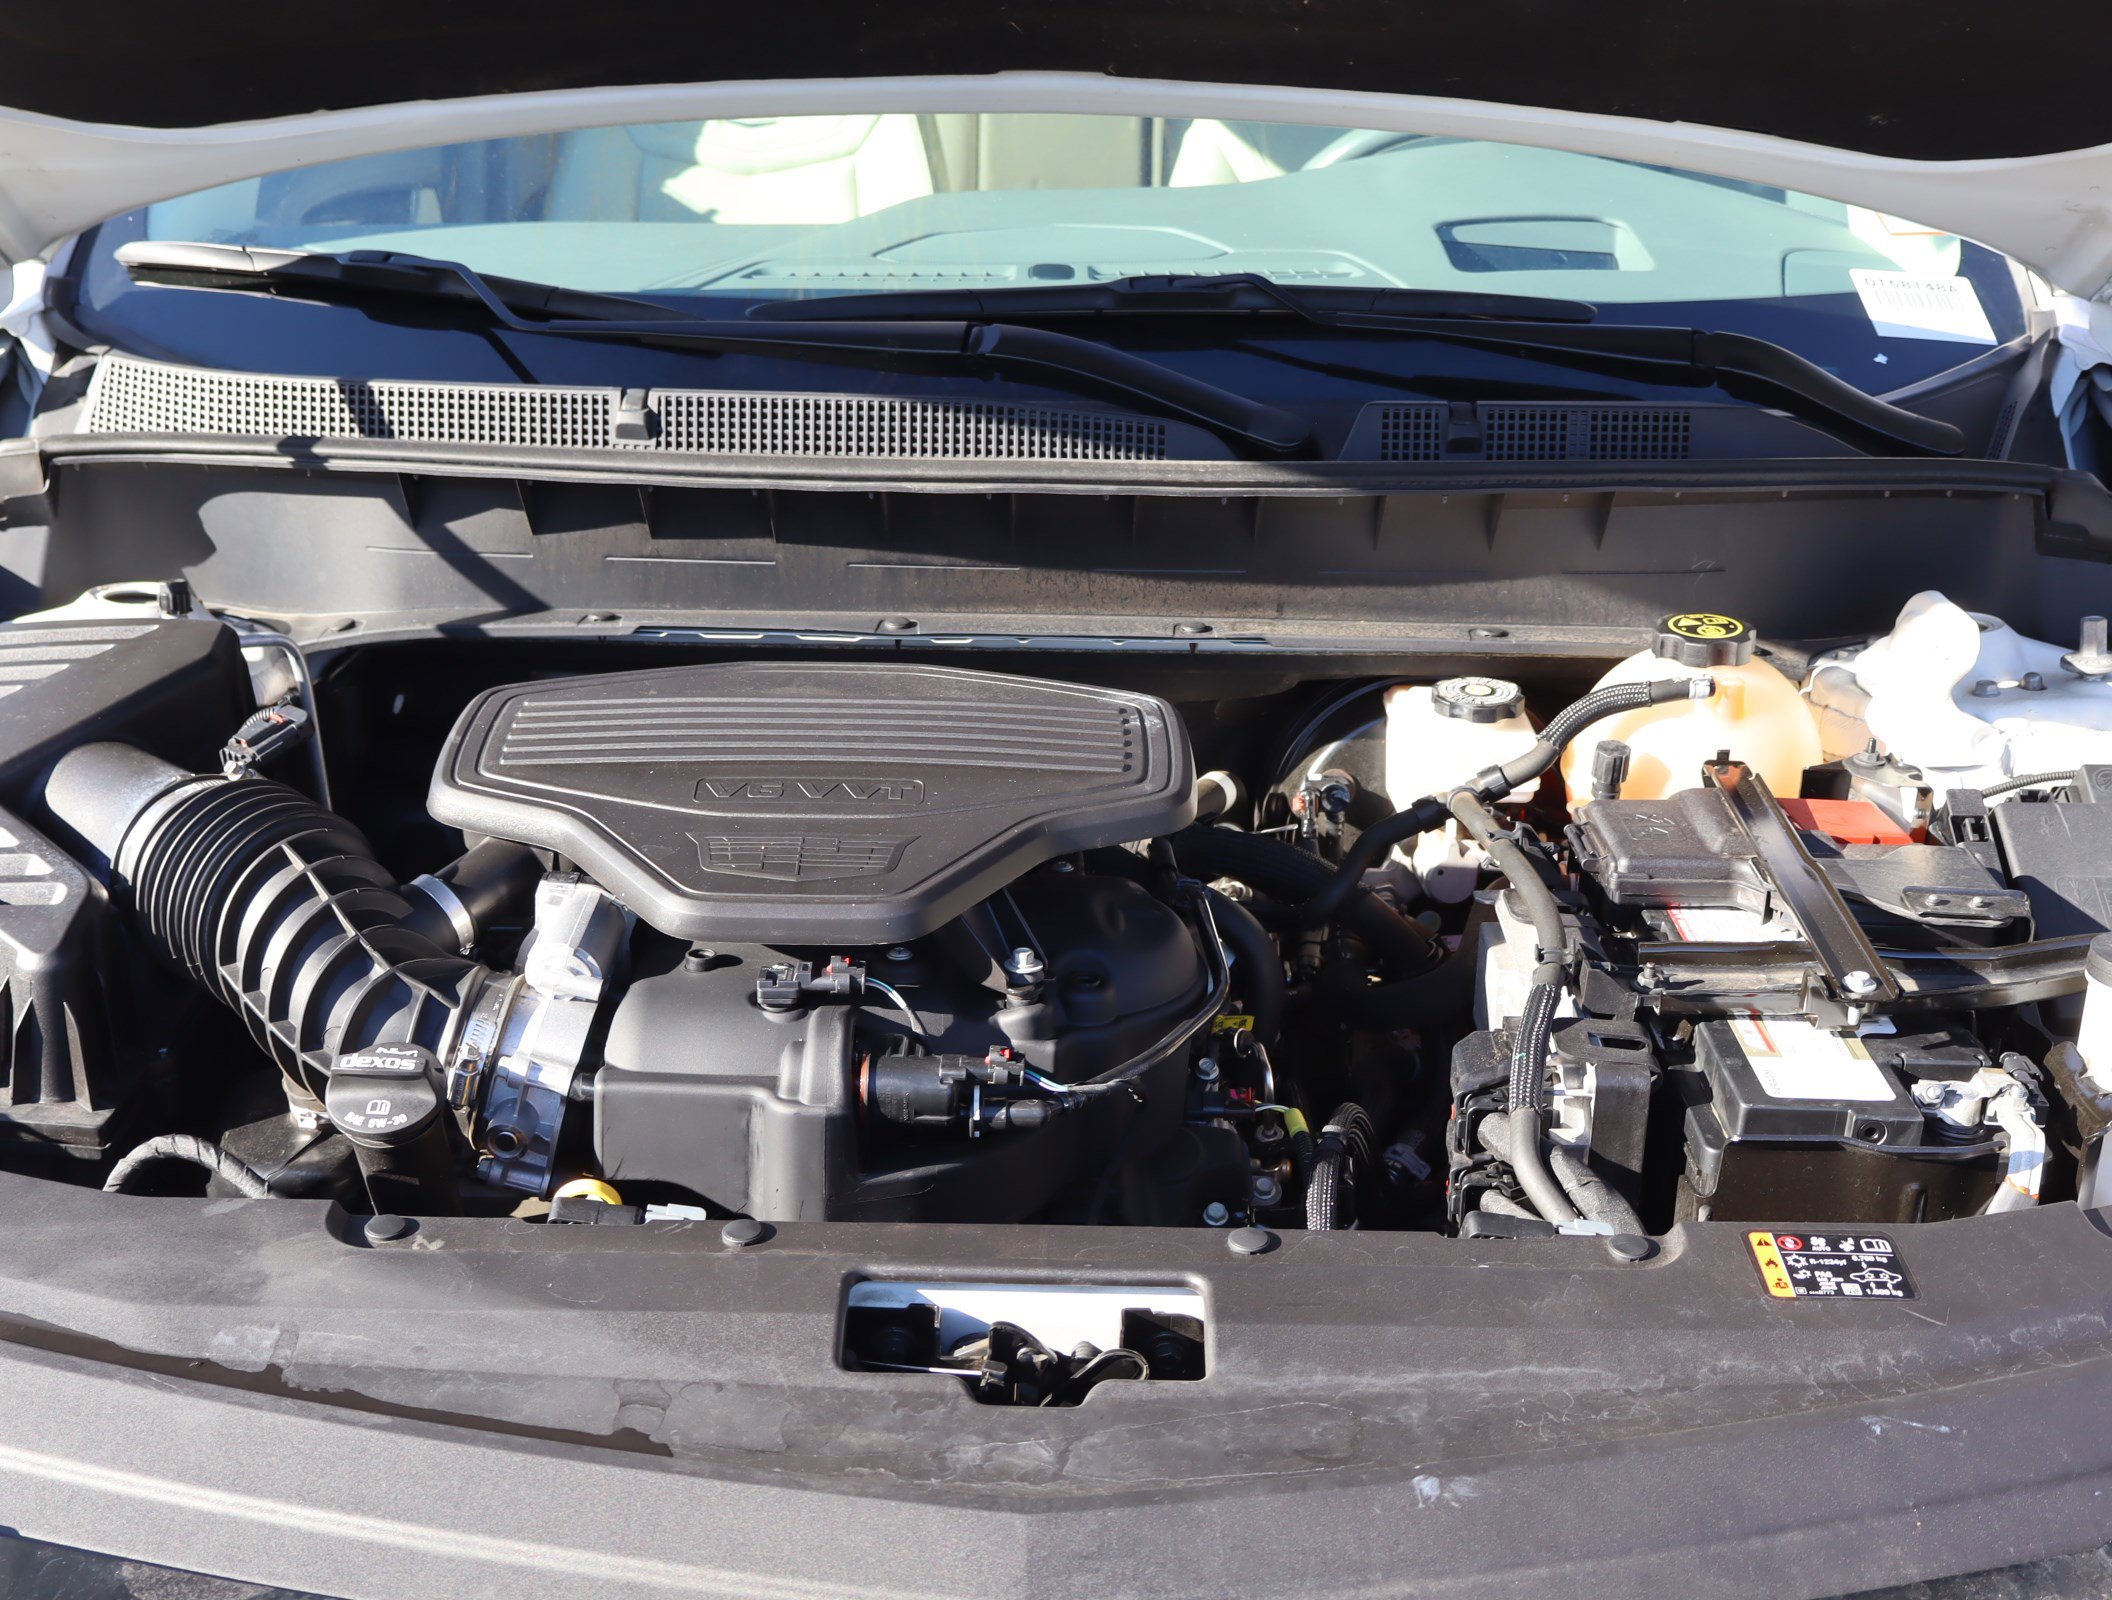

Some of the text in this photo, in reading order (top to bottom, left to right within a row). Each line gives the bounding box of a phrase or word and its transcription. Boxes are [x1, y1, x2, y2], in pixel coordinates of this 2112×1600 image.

[705, 782, 916, 800] V6 VVT
[340, 1053, 417, 1070] dexos
